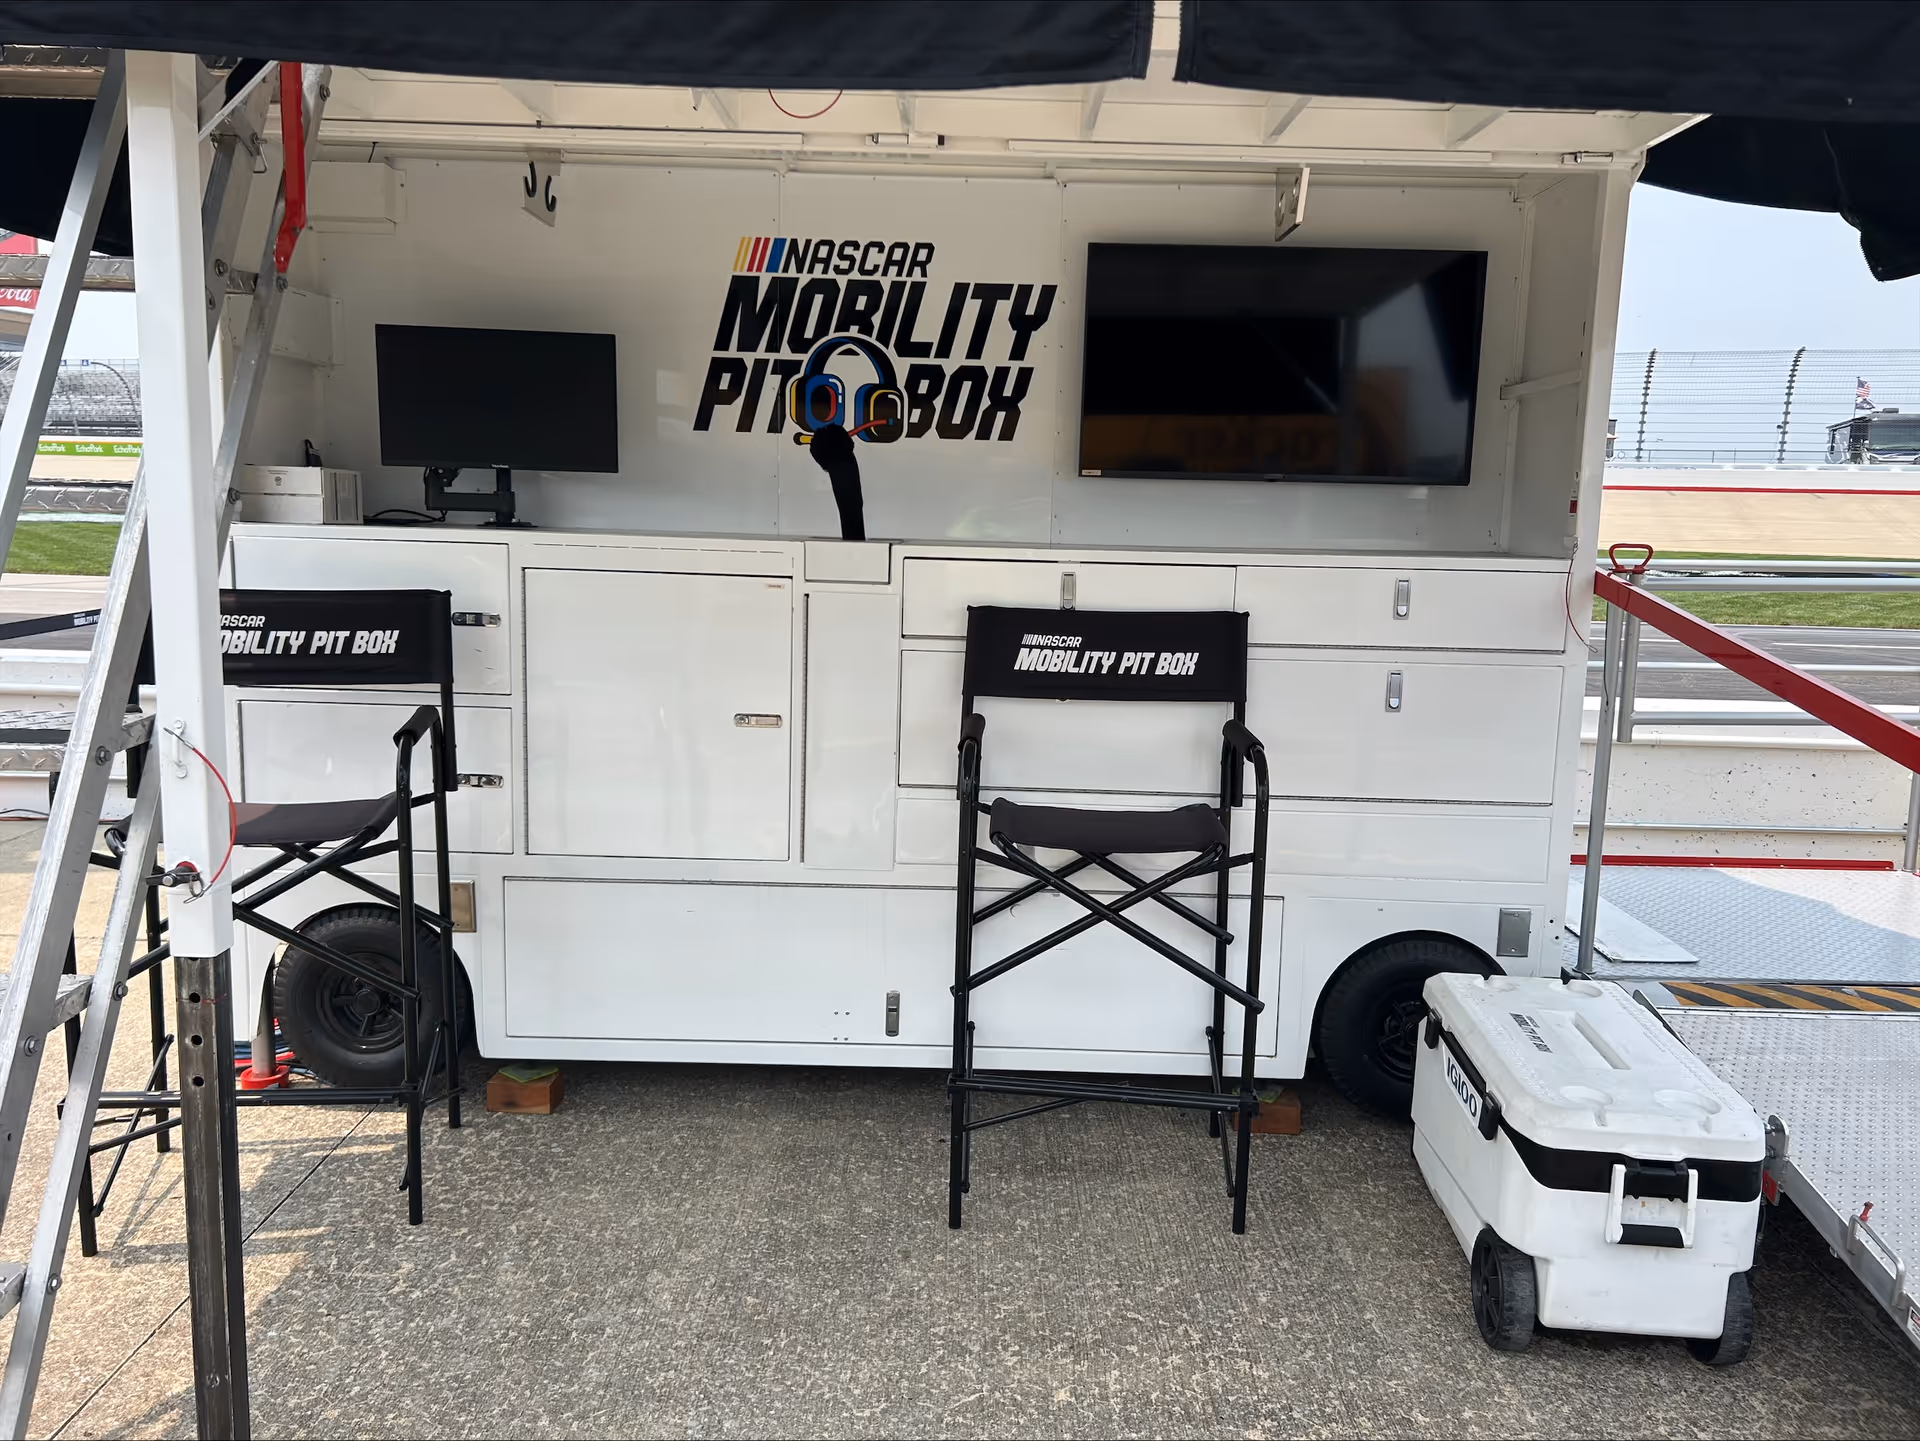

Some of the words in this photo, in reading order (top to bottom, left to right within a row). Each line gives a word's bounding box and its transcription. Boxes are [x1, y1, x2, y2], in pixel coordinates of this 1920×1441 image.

[782, 237, 936, 278] NASCAR
[712, 275, 1058, 362] MOBILITY
[692, 356, 804, 434] PIT
[904, 363, 1035, 442] BOX
[220, 629, 306, 655] OBILITY
[309, 630, 351, 655] PIT
[351, 629, 400, 655] BOX
[1013, 647, 1117, 675] MOBILITY
[1117, 651, 1156, 675] PIT
[1154, 652, 1200, 676] BOX
[1036, 634, 1083, 648] NASCAR
[1446, 1056, 1478, 1118] IGLOO
